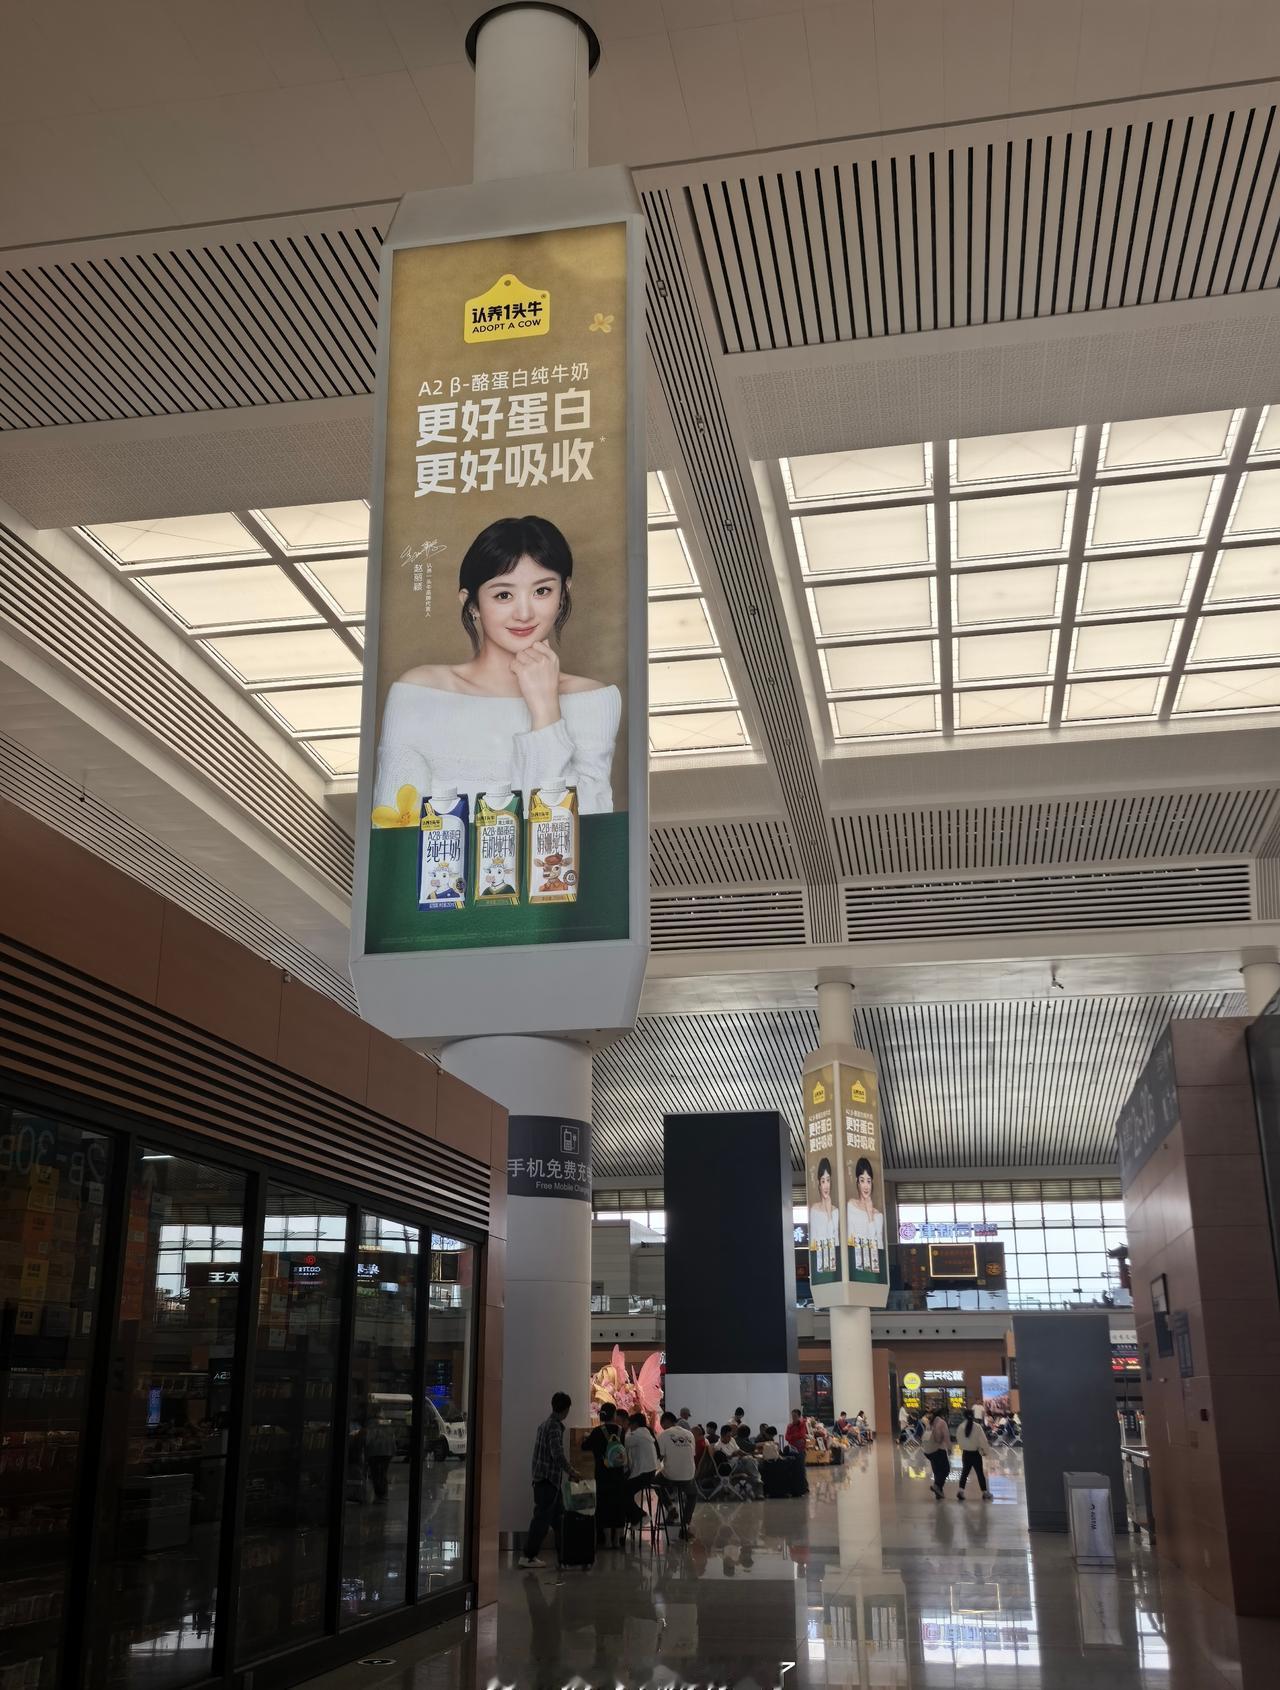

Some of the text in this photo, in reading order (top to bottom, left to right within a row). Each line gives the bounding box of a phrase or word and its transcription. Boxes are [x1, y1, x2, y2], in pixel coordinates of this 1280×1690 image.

[471, 301, 543, 324] 认养1头牛
[472, 318, 542, 334] ADOPT A COW
[418, 379, 443, 397] A2
[415, 387, 591, 448] 更好蛋白
[427, 840, 461, 863] 纯牛奶
[808, 1118, 832, 1137] 更好蛋白
[845, 1116, 874, 1136] 更好蛋白
[846, 1132, 875, 1152] 更好吸收
[535, 1181, 553, 1190] Free
[553, 1182, 574, 1192] Mobile
